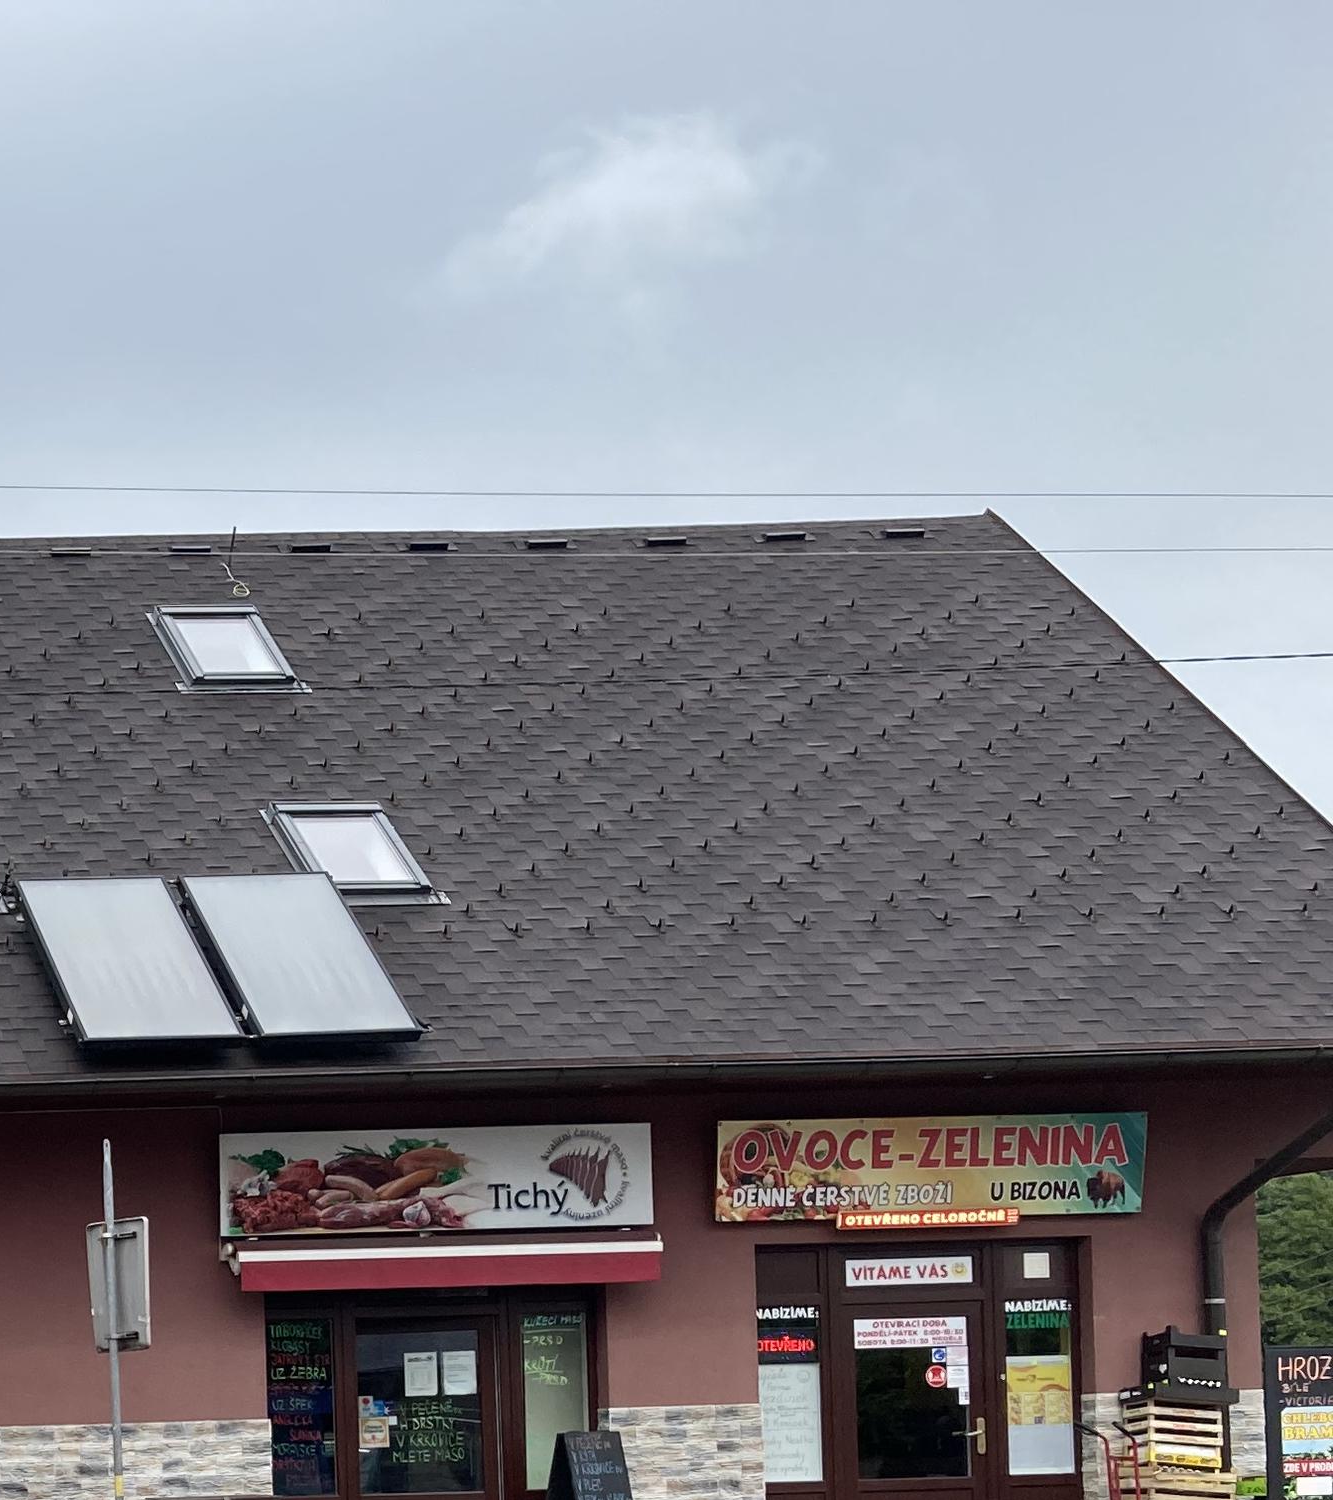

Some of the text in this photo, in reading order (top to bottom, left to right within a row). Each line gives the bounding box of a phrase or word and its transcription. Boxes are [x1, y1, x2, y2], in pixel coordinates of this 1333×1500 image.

[611, 1143, 629, 1170] maso
[732, 1123, 1130, 1172] OVOCE-ZELENINA
[487, 1180, 569, 1215] Tichý
[802, 1182, 890, 1207] ČERSTVÉ
[895, 1180, 953, 1205] ZBOŽÍ
[990, 1180, 1081, 1201] U BIZONA
[845, 1212, 920, 1226] OTEVŘENO
[923, 1208, 1006, 1224] CELOROČNĚ
[922, 1319, 947, 1328] DOBA
[1006, 1312, 1070, 1329] ZELENINA
[857, 1338, 888, 1346] SOBOTA
[1302, 1462, 1308, 1473] V
